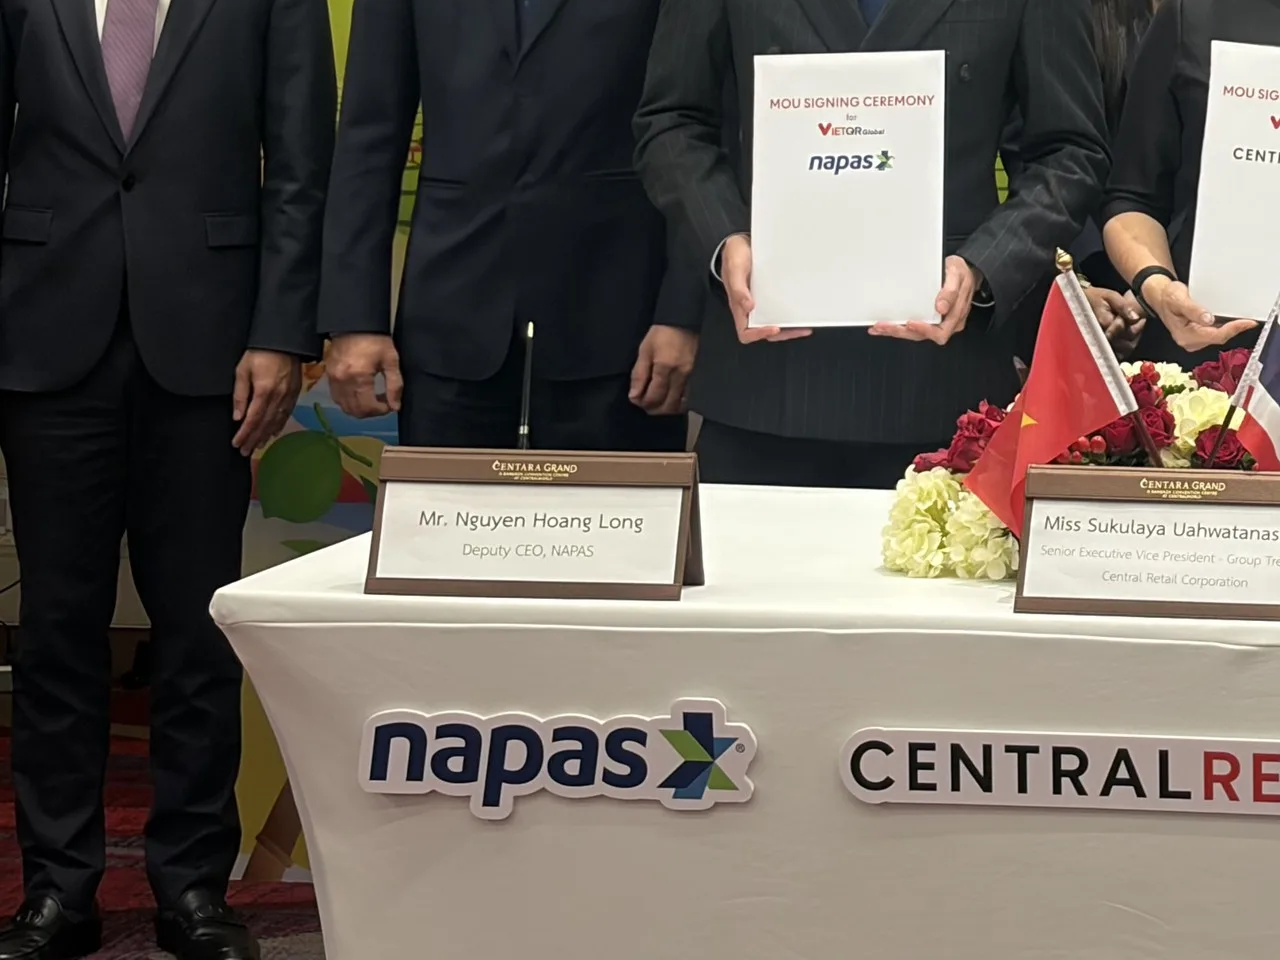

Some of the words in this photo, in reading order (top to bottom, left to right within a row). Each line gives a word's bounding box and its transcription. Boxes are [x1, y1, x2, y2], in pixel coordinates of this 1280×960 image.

[1223, 86, 1255, 98] MOU
[770, 99, 800, 109] MOU
[804, 97, 859, 108] SIGNING
[863, 95, 934, 107] CEREMONY
[818, 123, 862, 136] VIETQR
[809, 155, 873, 175] napas
[492, 460, 540, 473] CENTARA
[543, 463, 577, 474] GRAND
[1140, 477, 1190, 491] CENTARA
[1191, 481, 1225, 492] GRAND
[419, 511, 447, 526] Mr.
[456, 512, 525, 531] Nguyen
[533, 513, 591, 532] Hoang
[599, 514, 643, 533] Long
[1045, 516, 1080, 531] Miss
[1088, 518, 1165, 538] Sukulaya
[463, 544, 511, 559] Deputy
[516, 544, 546, 558] CEO,
[552, 545, 593, 557] NAPAS
[1041, 545, 1075, 556] Senior
[1079, 547, 1132, 559] Executive
[1136, 550, 1159, 560] Vice
[1163, 551, 1215, 563] President
[1227, 554, 1261, 568] Group
[1102, 571, 1142, 584] Central
[1147, 573, 1177, 584] Retail
[1182, 574, 1248, 588] Corporation
[369, 723, 653, 807] napas
